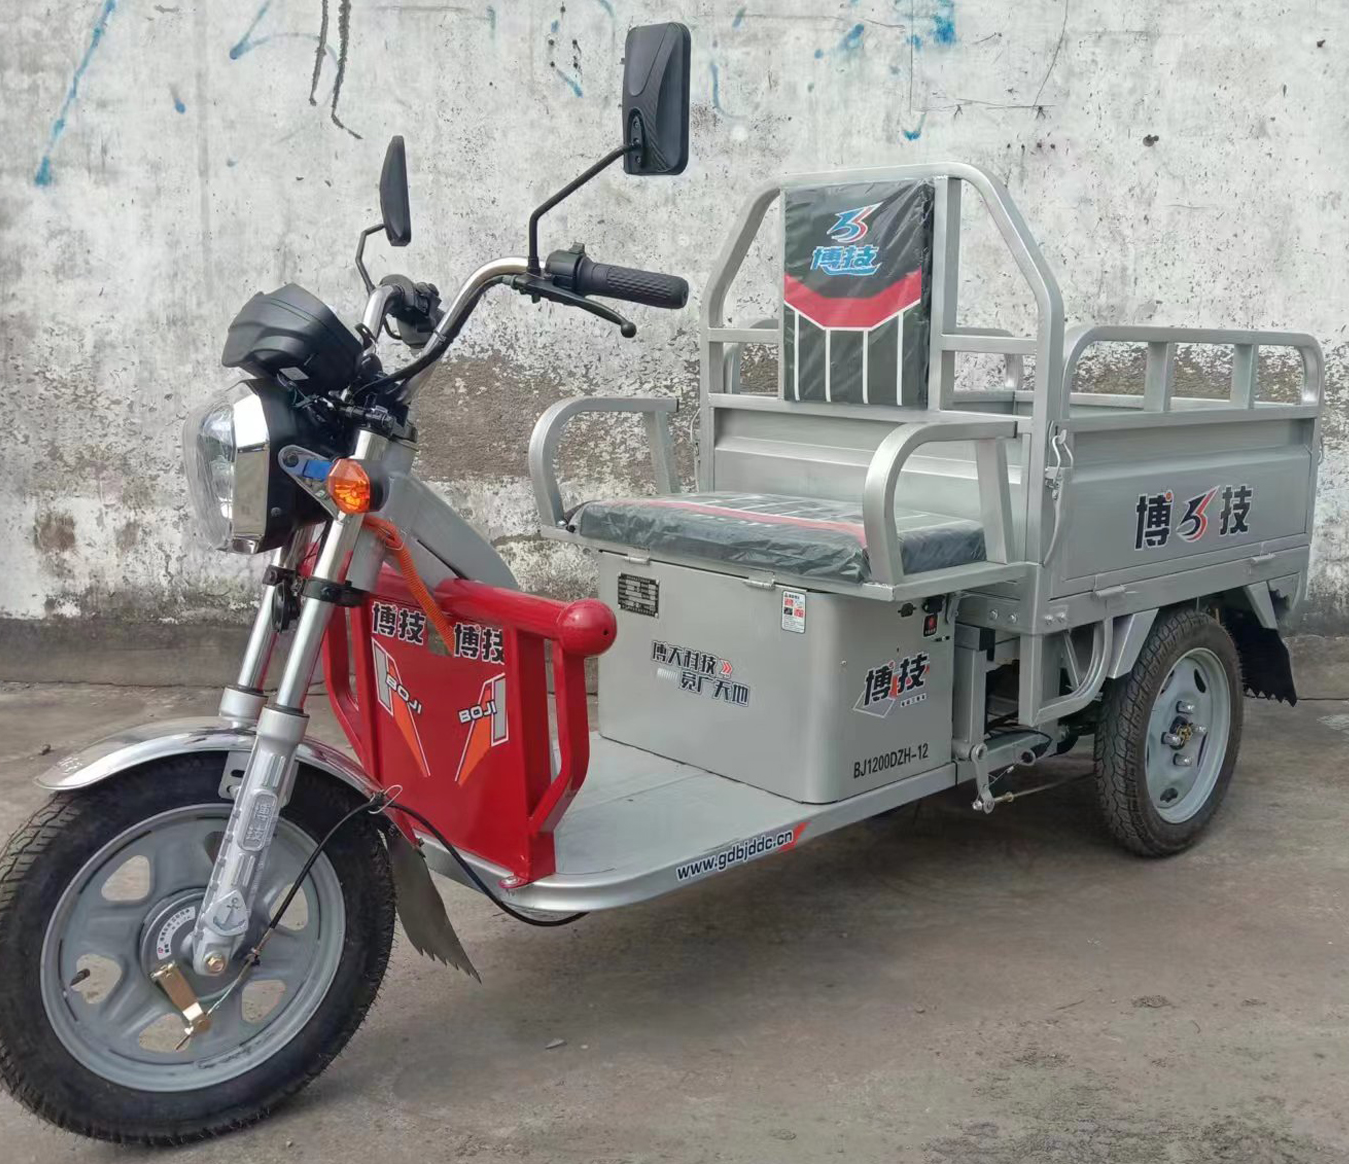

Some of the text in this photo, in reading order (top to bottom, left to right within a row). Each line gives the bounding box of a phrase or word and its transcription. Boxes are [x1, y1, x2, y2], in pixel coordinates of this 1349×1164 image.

[810, 245, 882, 275] 博技
[372, 601, 426, 645] 博技
[652, 641, 717, 675] 博大科技
[385, 671, 423, 715] BOJI
[680, 670, 749, 706] 宽广天地
[863, 651, 929, 706] 博技
[458, 700, 498, 724] BOJI
[853, 742, 929, 779] BJ1200DZH-12
[676, 830, 793, 881] www.gdbjddc.cn
